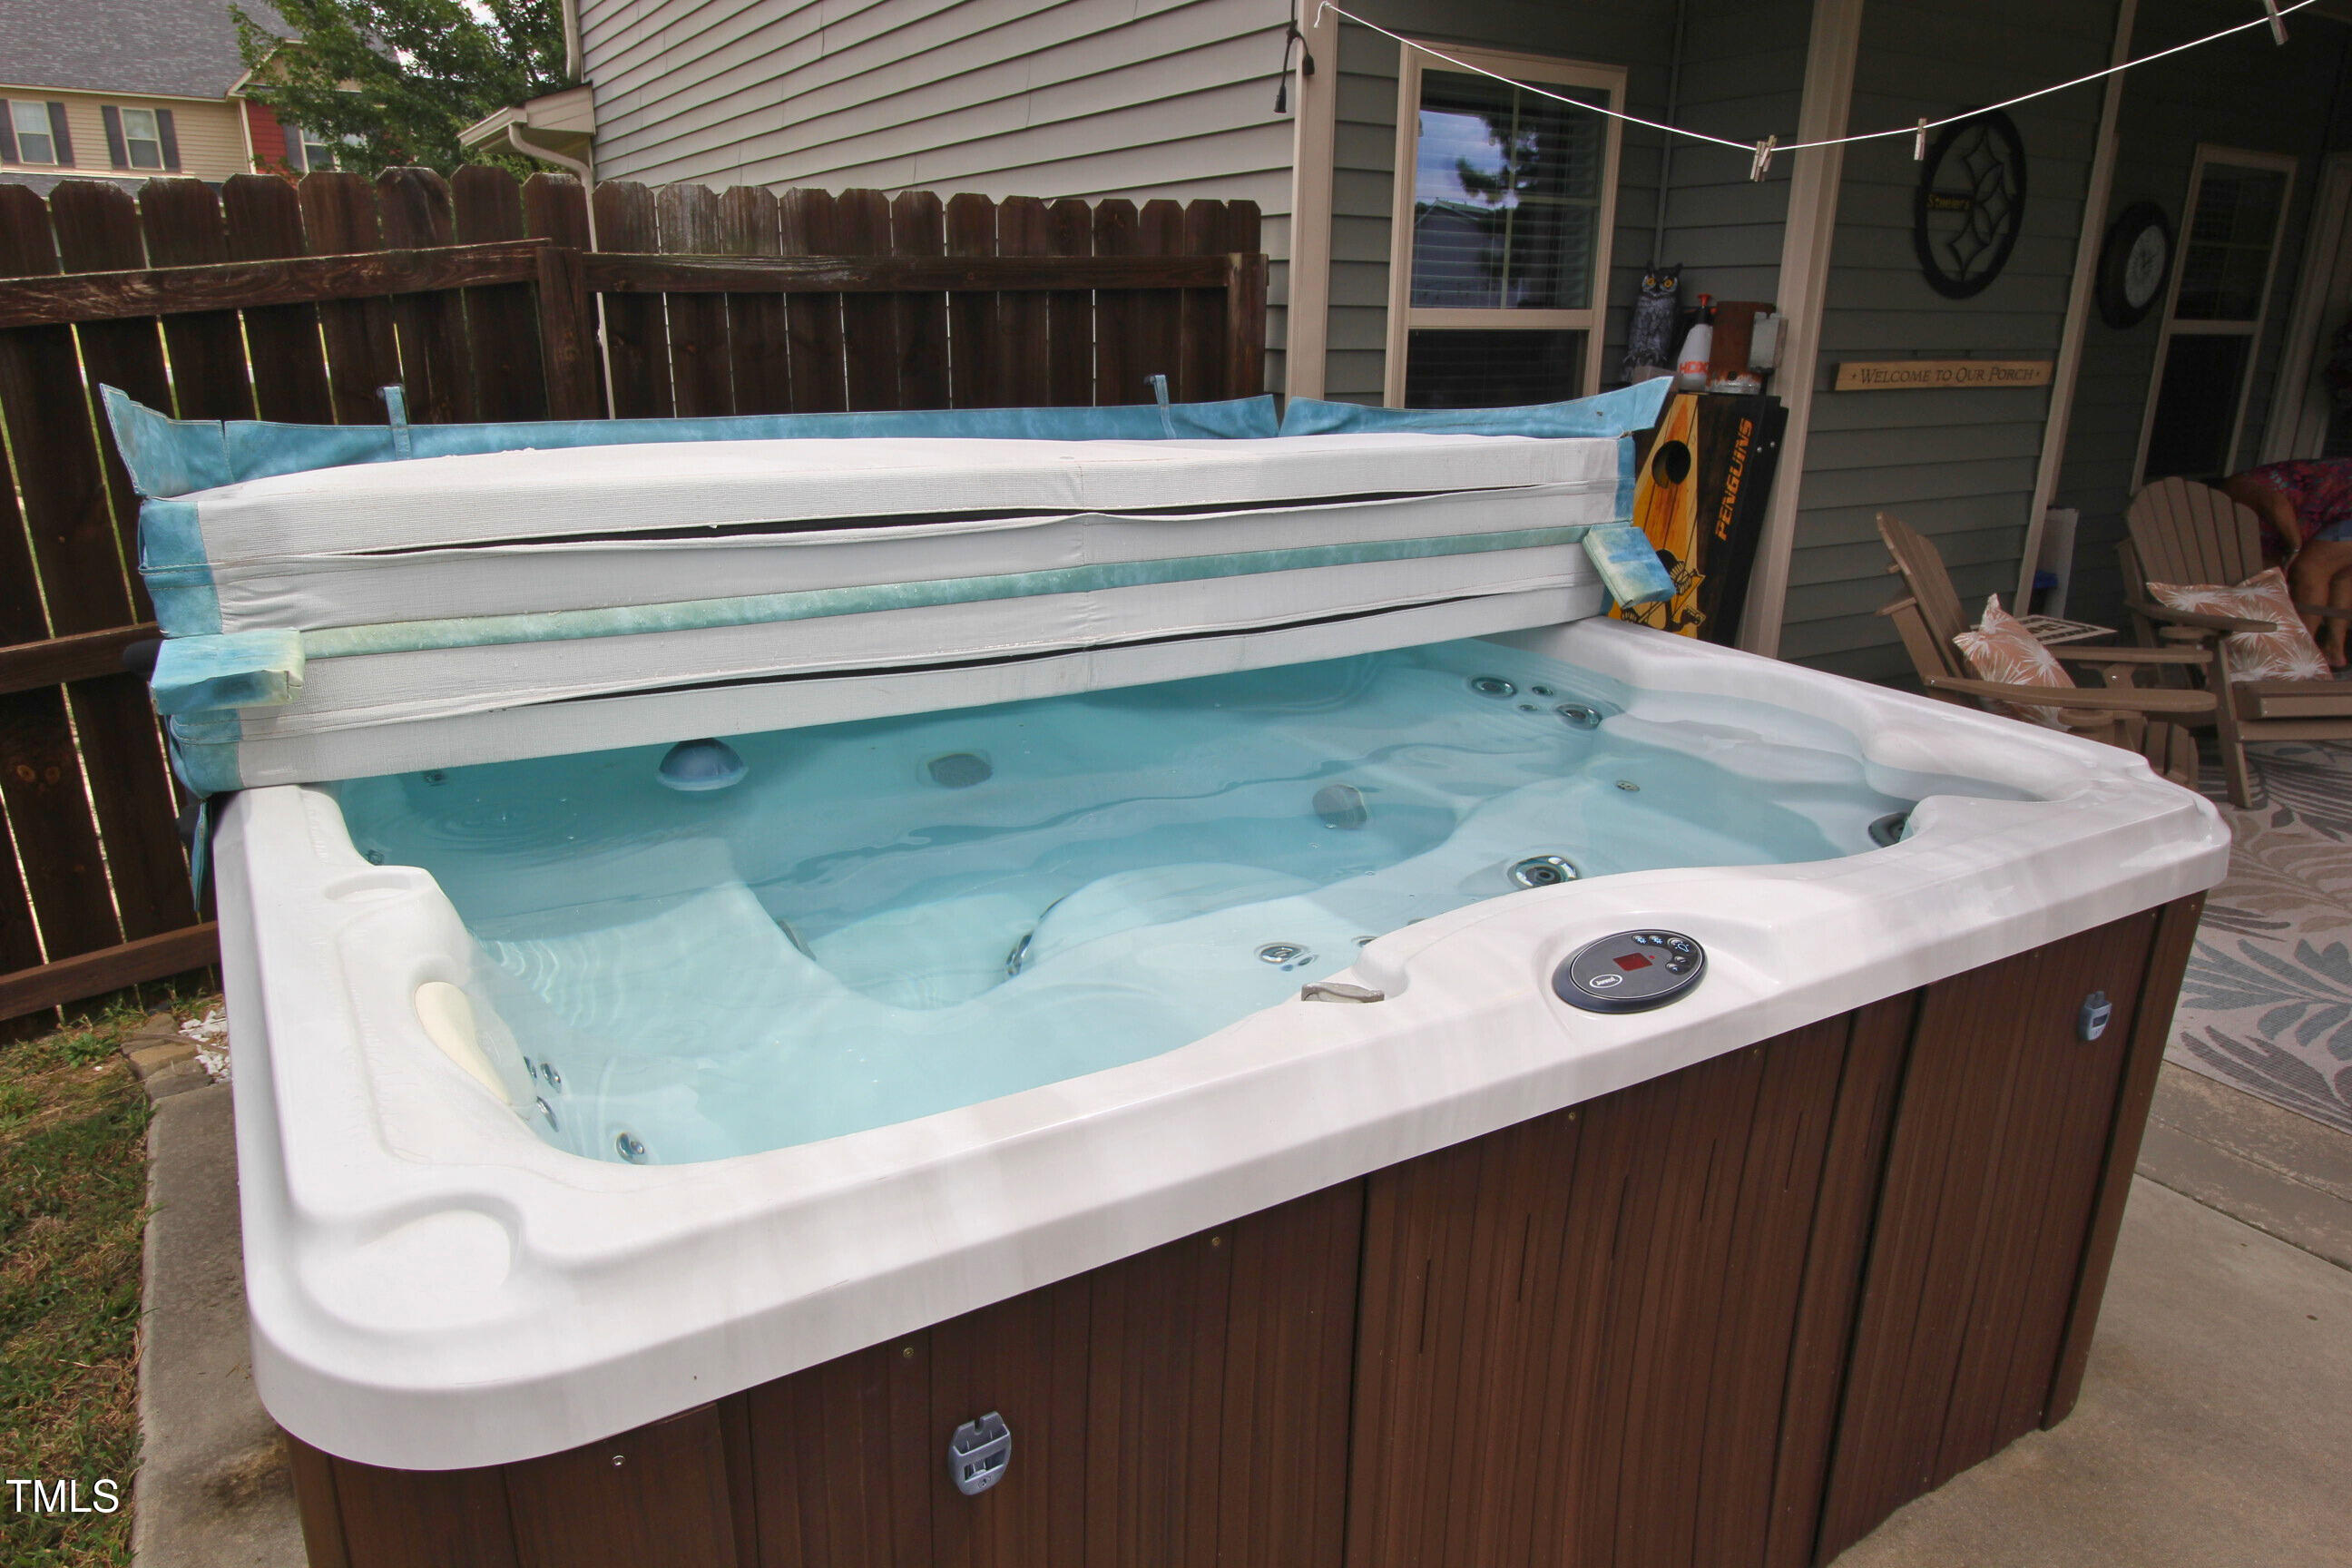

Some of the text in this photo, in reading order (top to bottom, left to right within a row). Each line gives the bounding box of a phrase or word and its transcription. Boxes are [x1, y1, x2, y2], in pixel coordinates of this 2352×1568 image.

[1861, 368, 1931, 383] WELCOME
[1956, 367, 1984, 382] OUR
[1988, 367, 2034, 381] PORCH
[1715, 417, 1754, 542] PENGUINS
